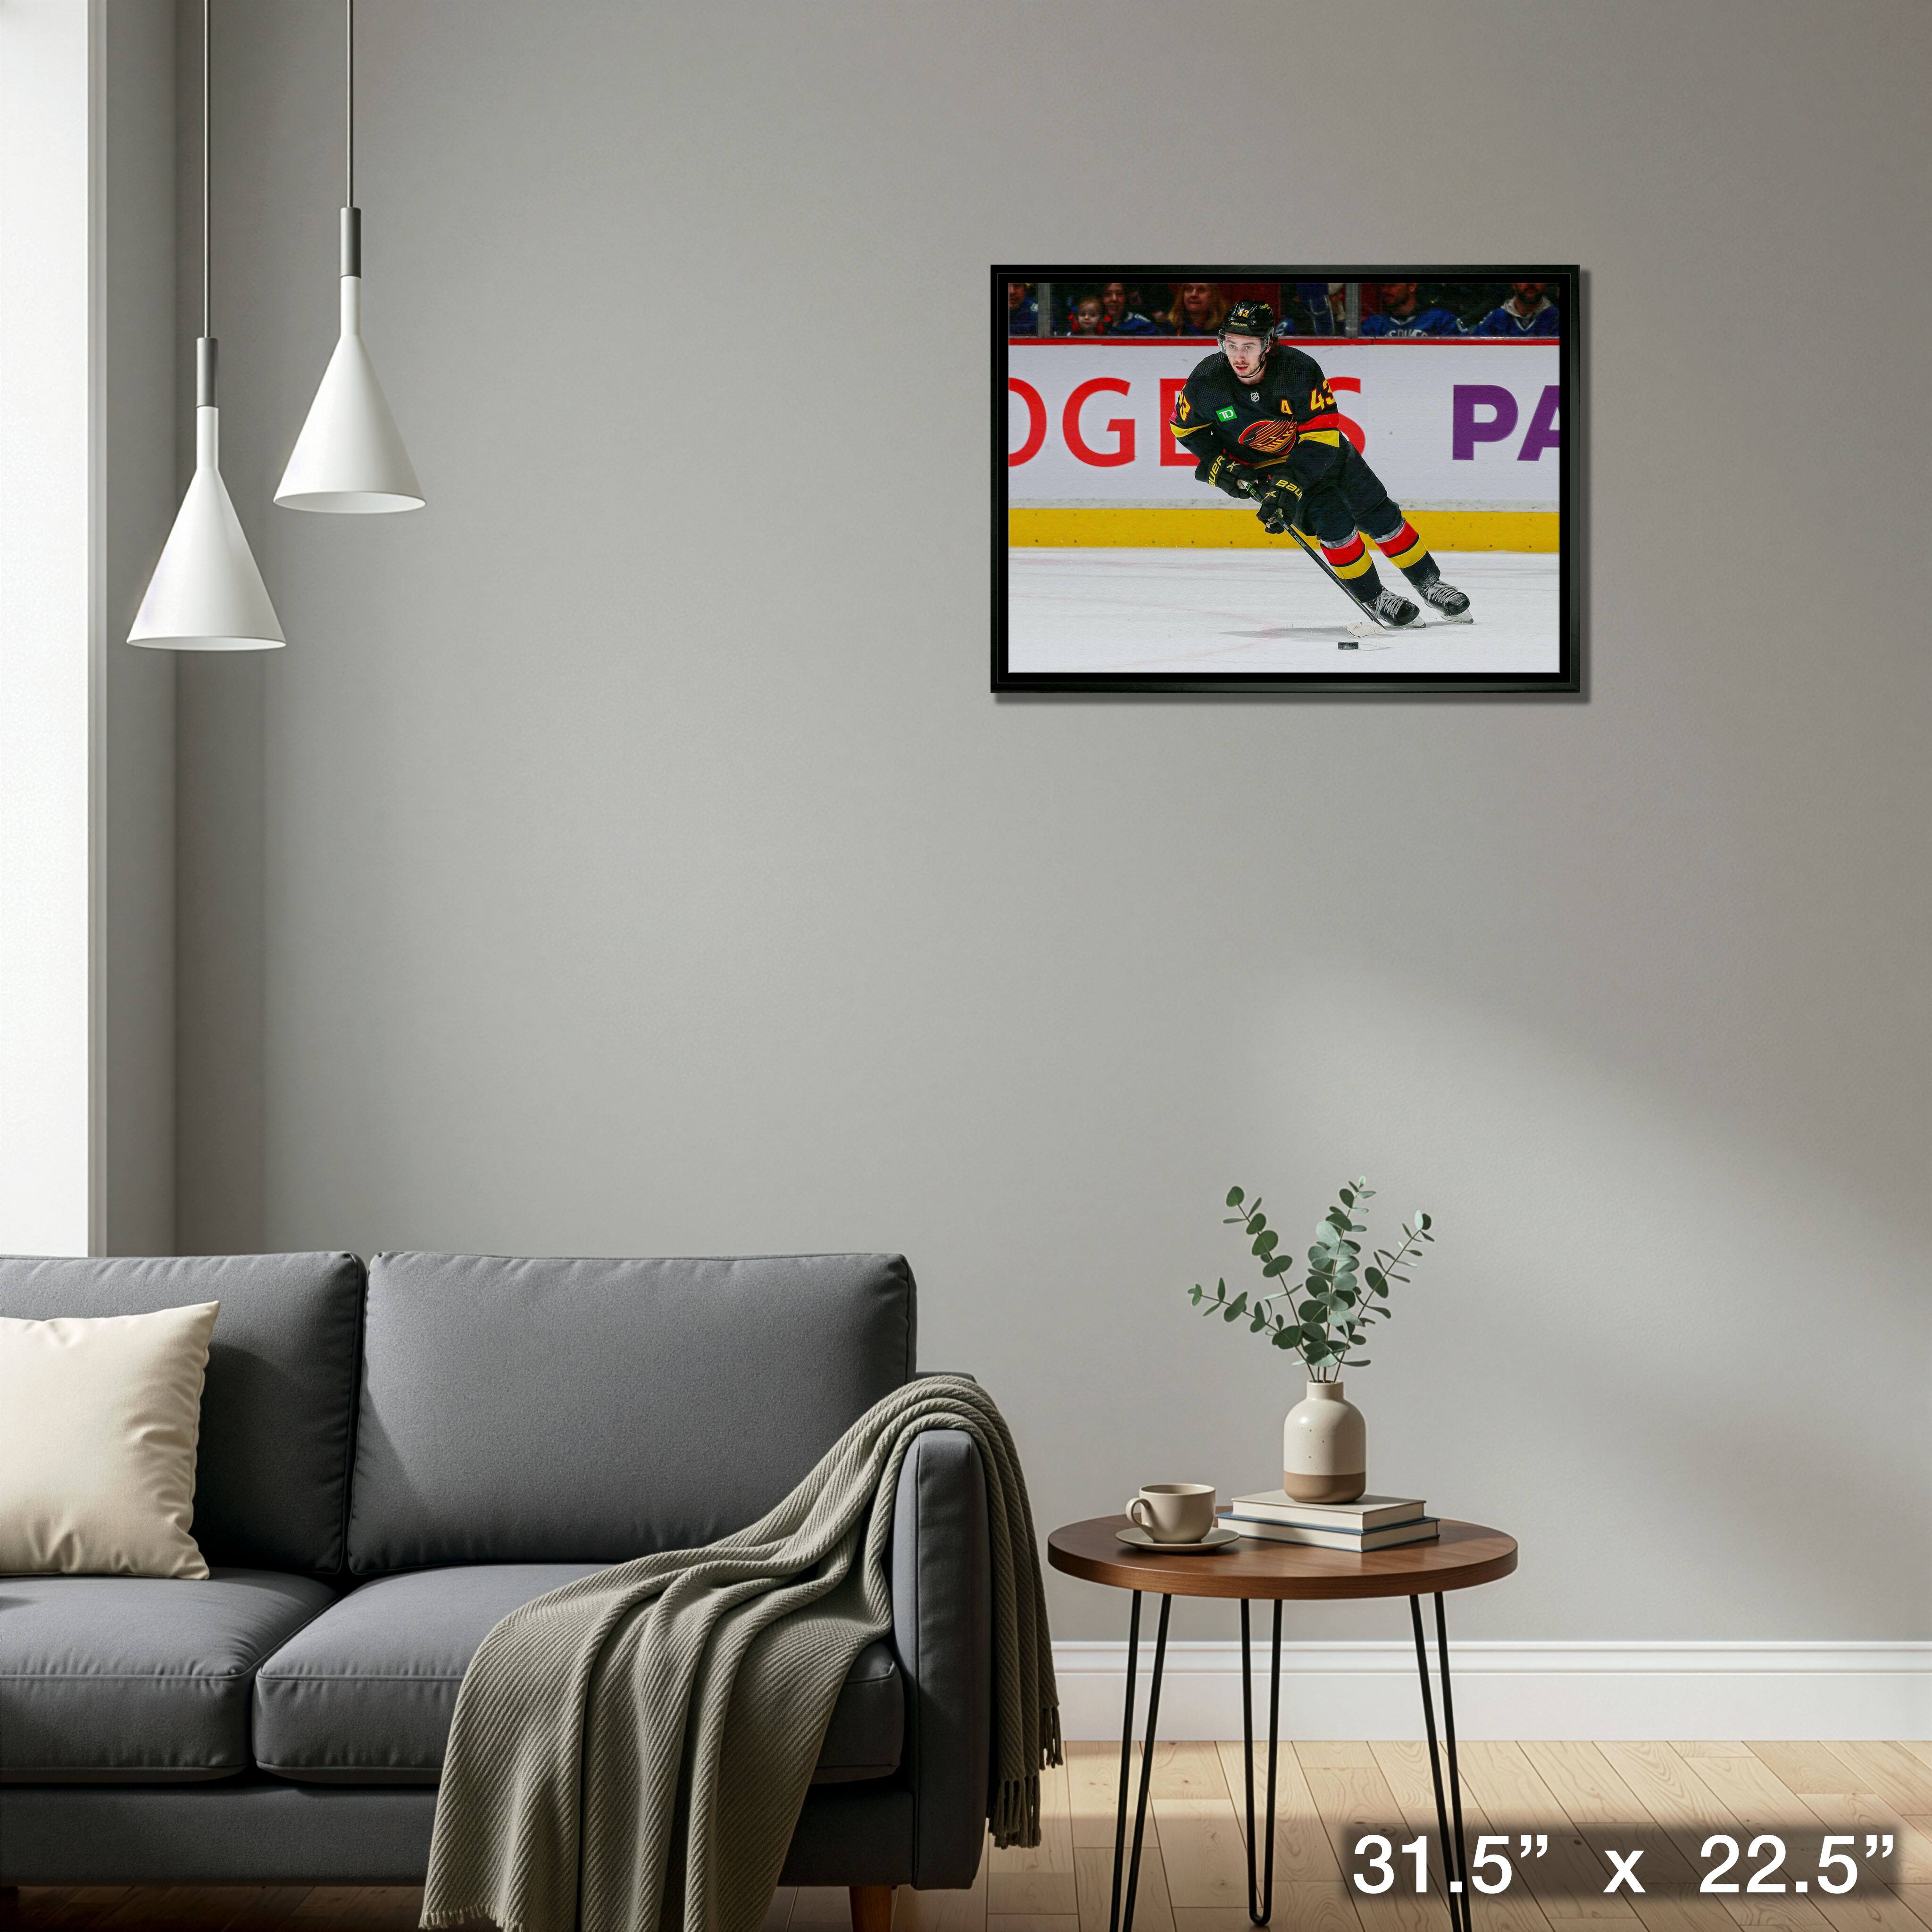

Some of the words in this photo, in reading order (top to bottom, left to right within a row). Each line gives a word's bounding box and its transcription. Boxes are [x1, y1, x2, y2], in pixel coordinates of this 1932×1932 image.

[1237, 309, 1249, 317] 43
[1281, 400, 1293, 415] A
[1218, 409, 1234, 419] TD
